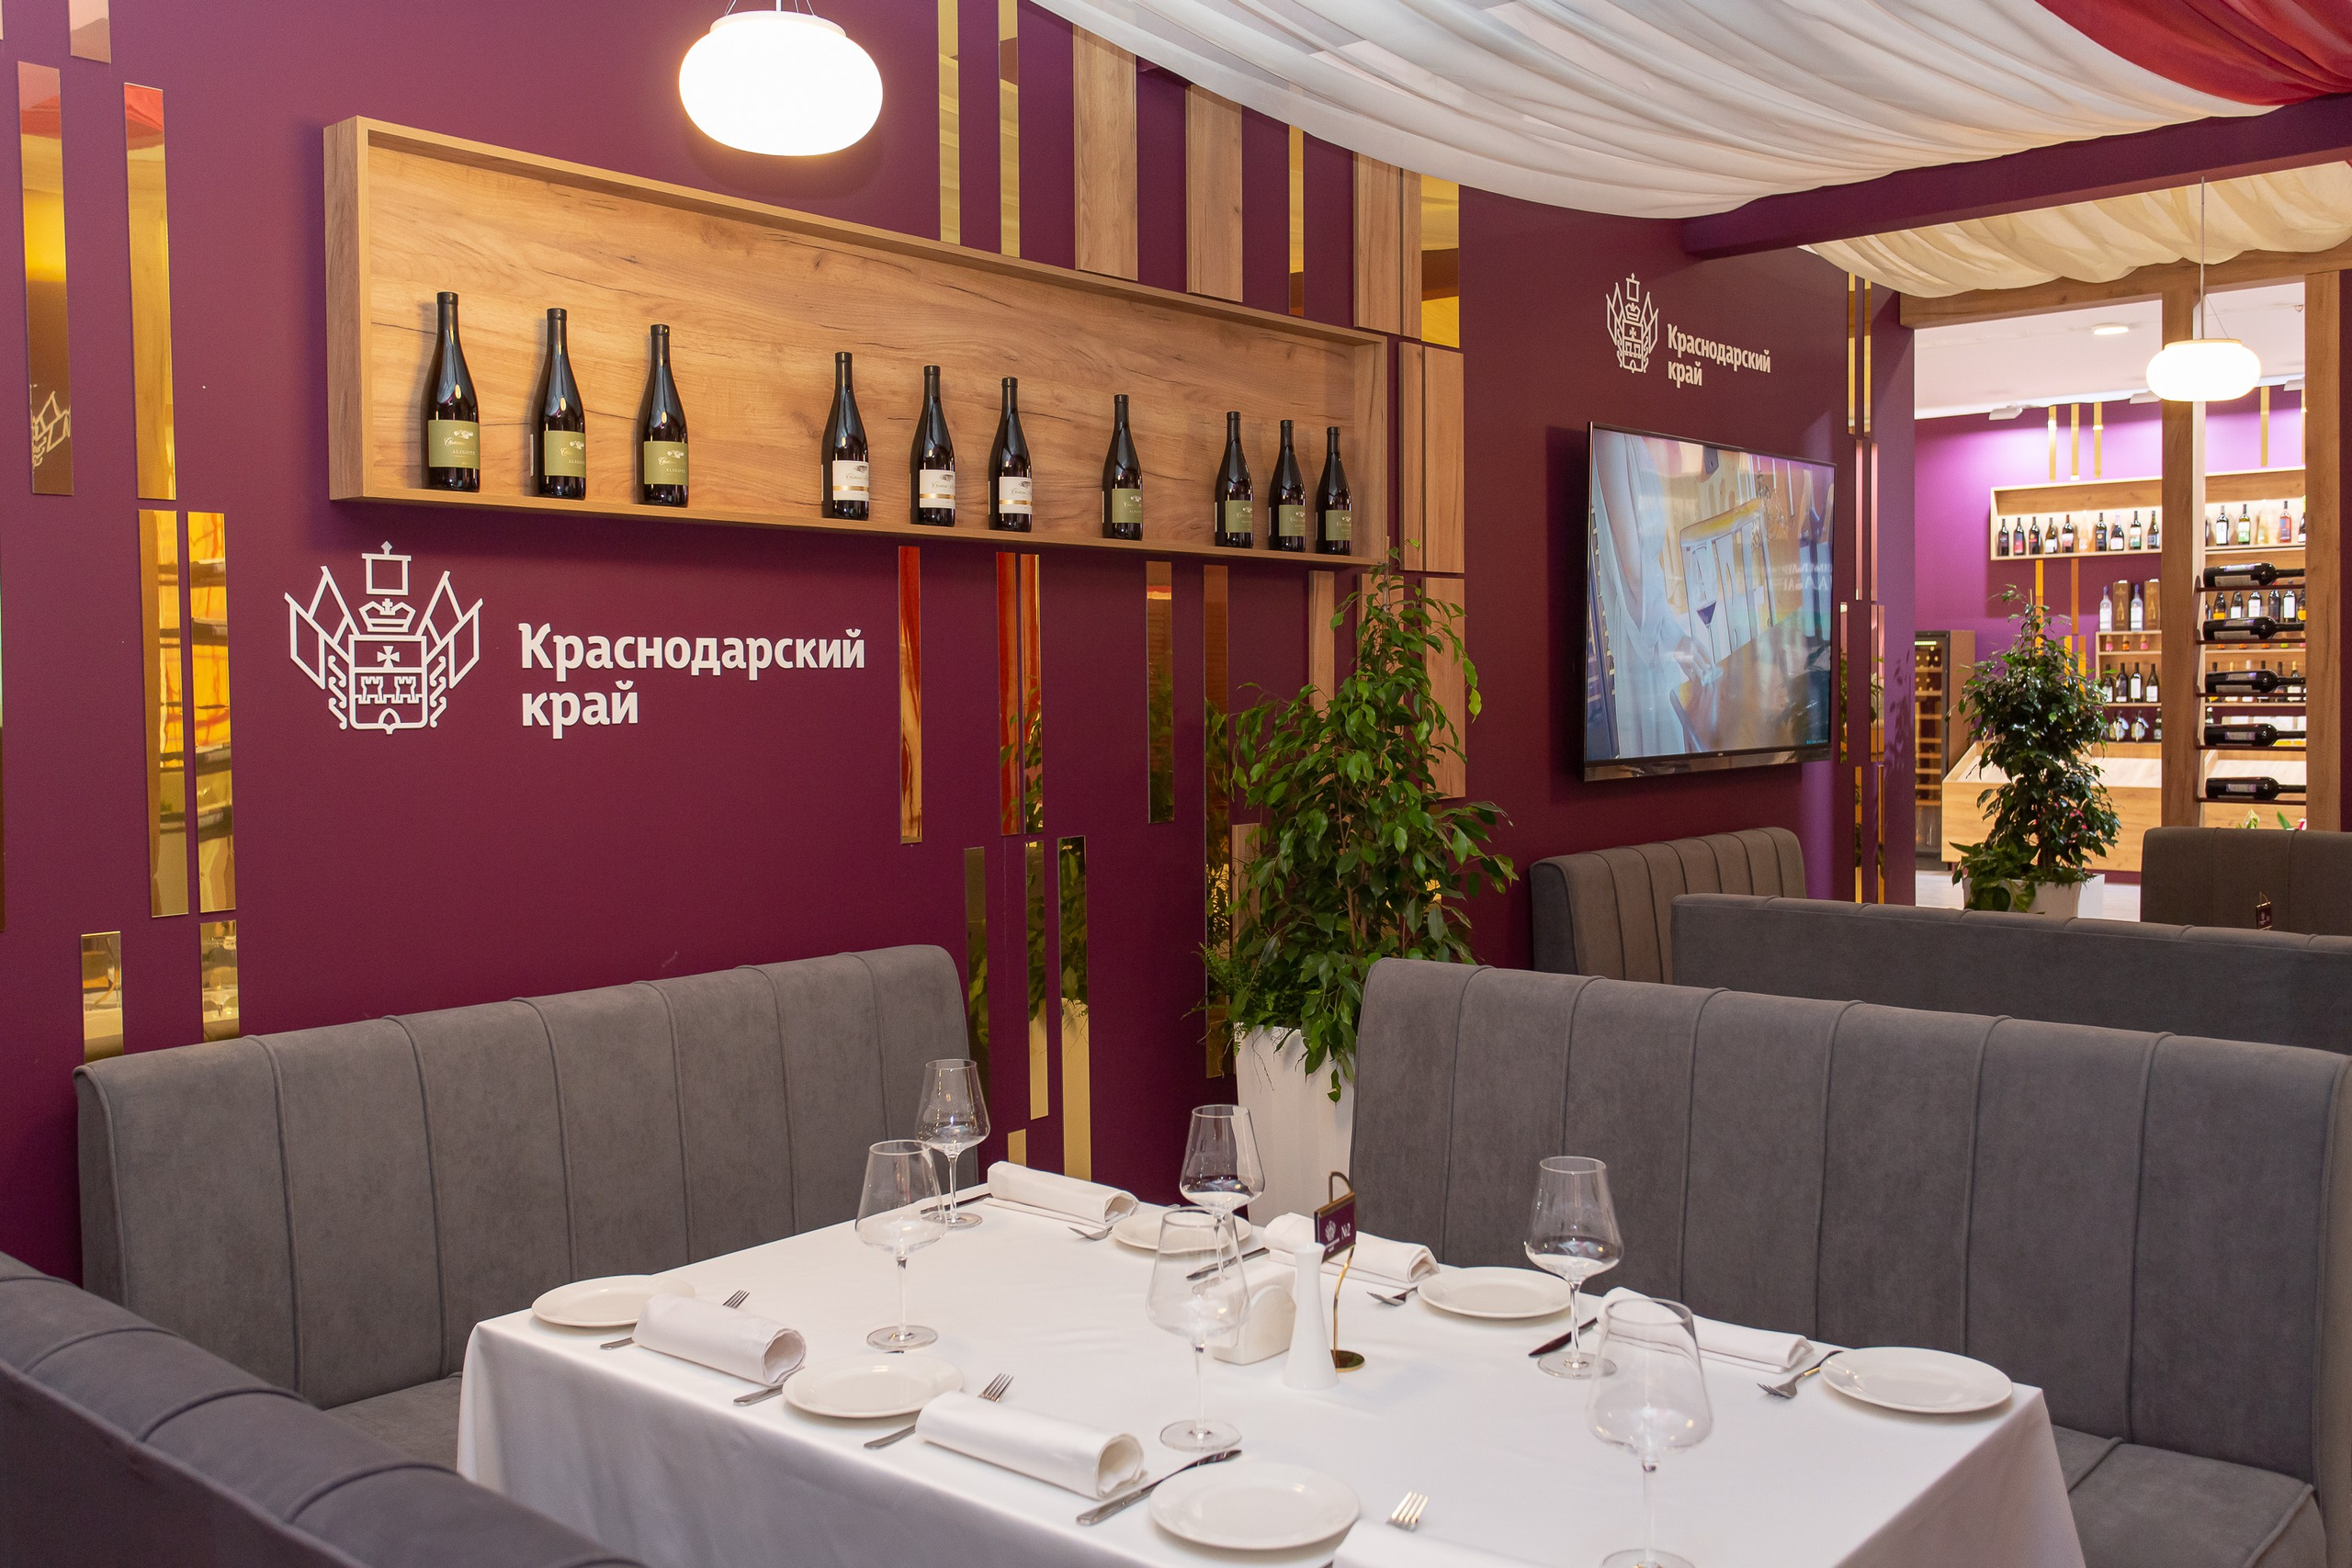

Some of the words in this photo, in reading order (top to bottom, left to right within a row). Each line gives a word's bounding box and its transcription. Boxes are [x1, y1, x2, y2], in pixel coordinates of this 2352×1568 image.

[1667, 323, 1771, 373] Краснодарский
[1668, 361, 1702, 389] край
[517, 622, 865, 682] Краснодарский
[521, 680, 639, 739] край
